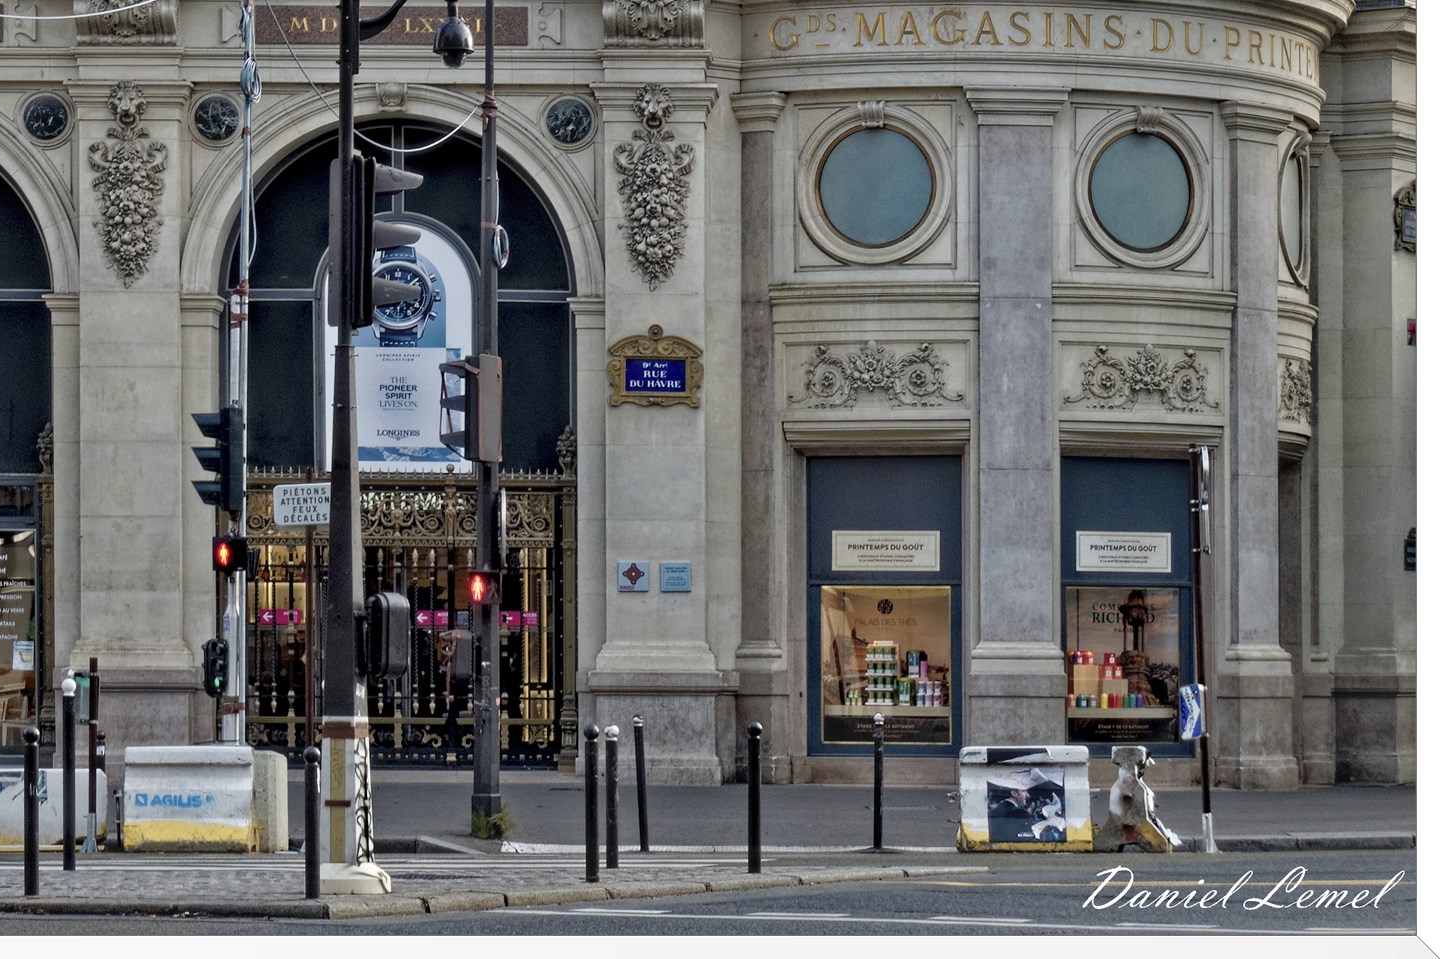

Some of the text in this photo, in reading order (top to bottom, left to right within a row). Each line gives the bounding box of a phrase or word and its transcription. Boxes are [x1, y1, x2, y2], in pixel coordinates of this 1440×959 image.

[288, 16, 310, 34] M
[852, 10, 1127, 50] MAGASINS
[1150, 17, 1206, 57] DU
[1223, 25, 1320, 82] PRINTE
[643, 370, 667, 379] RUE
[390, 376, 408, 384] THE
[629, 380, 644, 388] DU
[379, 400, 403, 408] LIVES
[376, 429, 421, 437] LONGINES
[283, 487, 327, 497] PIÉTONS
[281, 496, 330, 506] ATTENTION
[292, 505, 317, 514] FEUX
[283, 512, 328, 523] DÉCALÉS
[902, 542, 924, 551] GOÛT
[1138, 544, 1157, 552] GOÛT
[854, 618, 880, 626] PALAIS
[898, 617, 917, 626] THÉS
[150, 794, 201, 808] AGILIS
